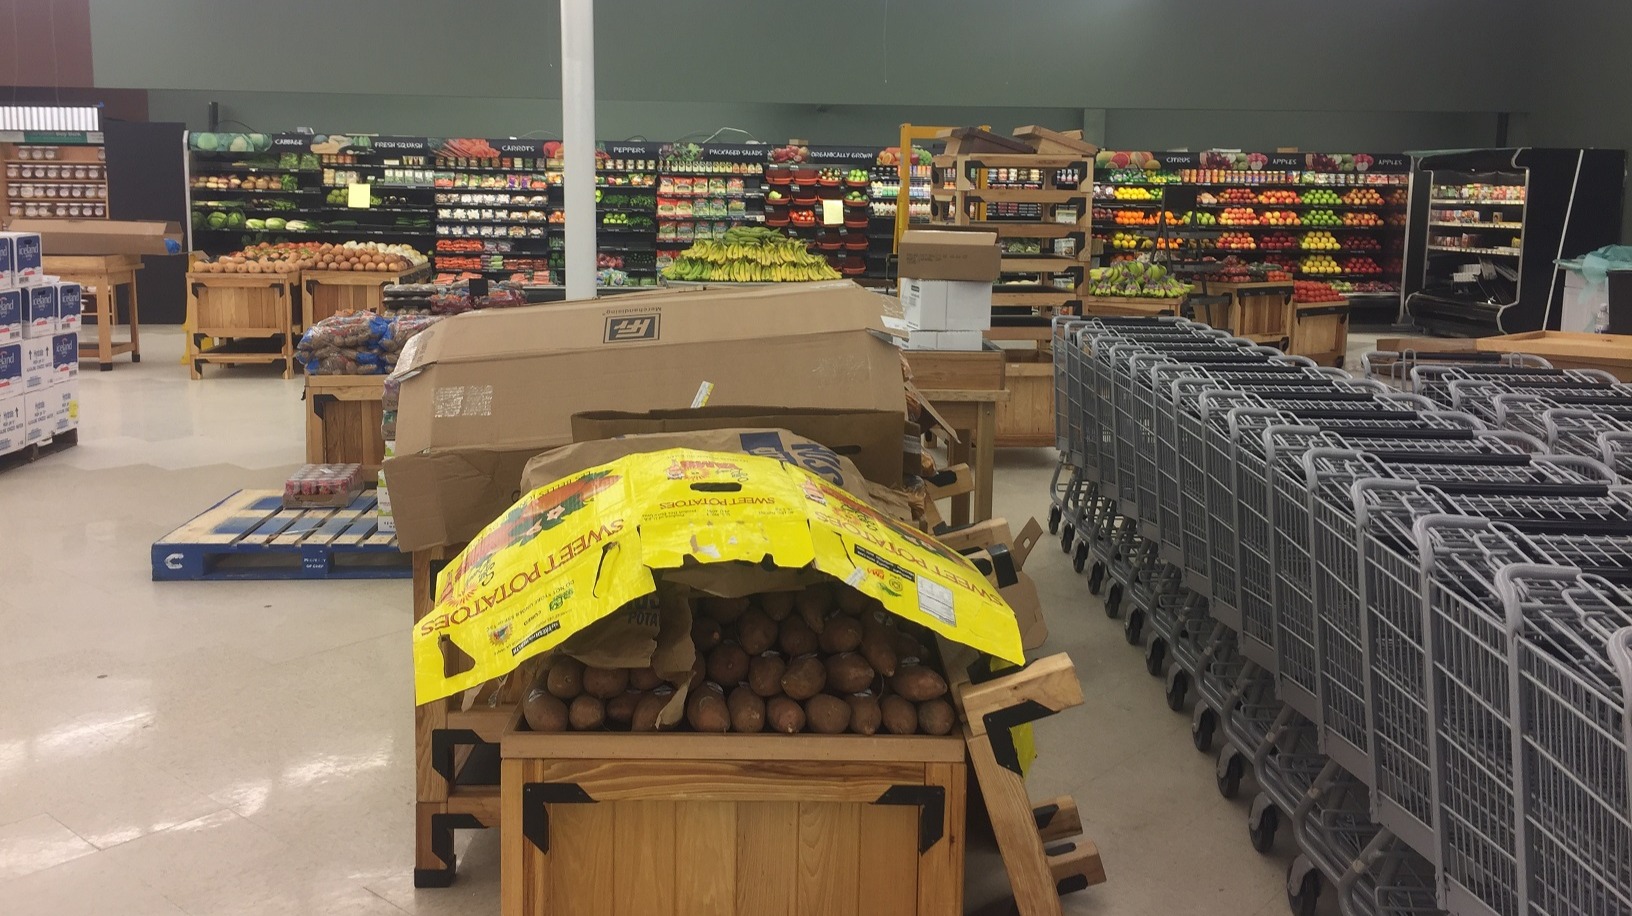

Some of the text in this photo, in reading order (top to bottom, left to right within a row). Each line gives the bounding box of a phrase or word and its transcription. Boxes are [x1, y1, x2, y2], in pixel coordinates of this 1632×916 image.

[275, 138, 303, 146] CABBAGE
[374, 141, 395, 149] FRESH
[501, 144, 535, 152] CARROTS
[613, 146, 646, 154] PEPPERS
[709, 149, 763, 157] PACKAGED SALADS
[811, 151, 873, 159] ORGANICALLY GROWN
[1166, 156, 1190, 164] CITRUS
[660, 496, 775, 510] SWEET POTATOES
[814, 511, 927, 573] POTATOES
[544, 518, 625, 576] SWEET
[931, 565, 1003, 607] SWEET
[421, 561, 541, 637] POTATOES
